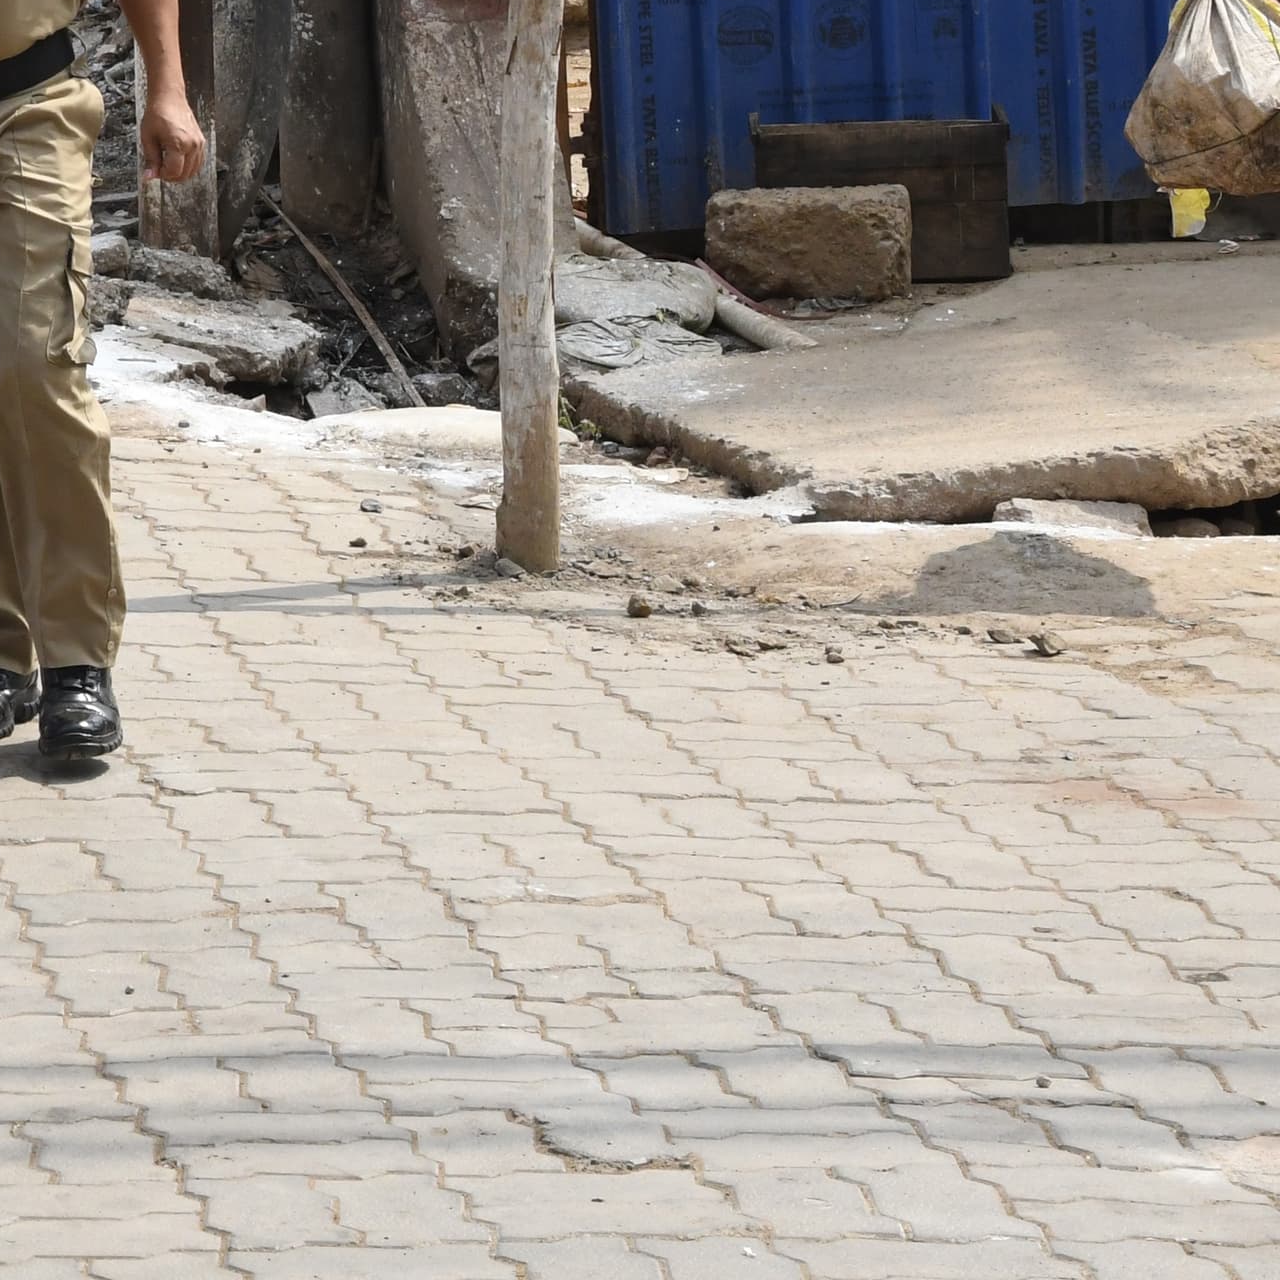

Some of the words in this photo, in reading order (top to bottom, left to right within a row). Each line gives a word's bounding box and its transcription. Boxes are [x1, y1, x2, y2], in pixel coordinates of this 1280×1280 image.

[639, 24, 656, 68] STEEL
[1034, 8, 1049, 58] TATA
[1082, 26, 1097, 77] TATA
[643, 94, 658, 143] TATA
